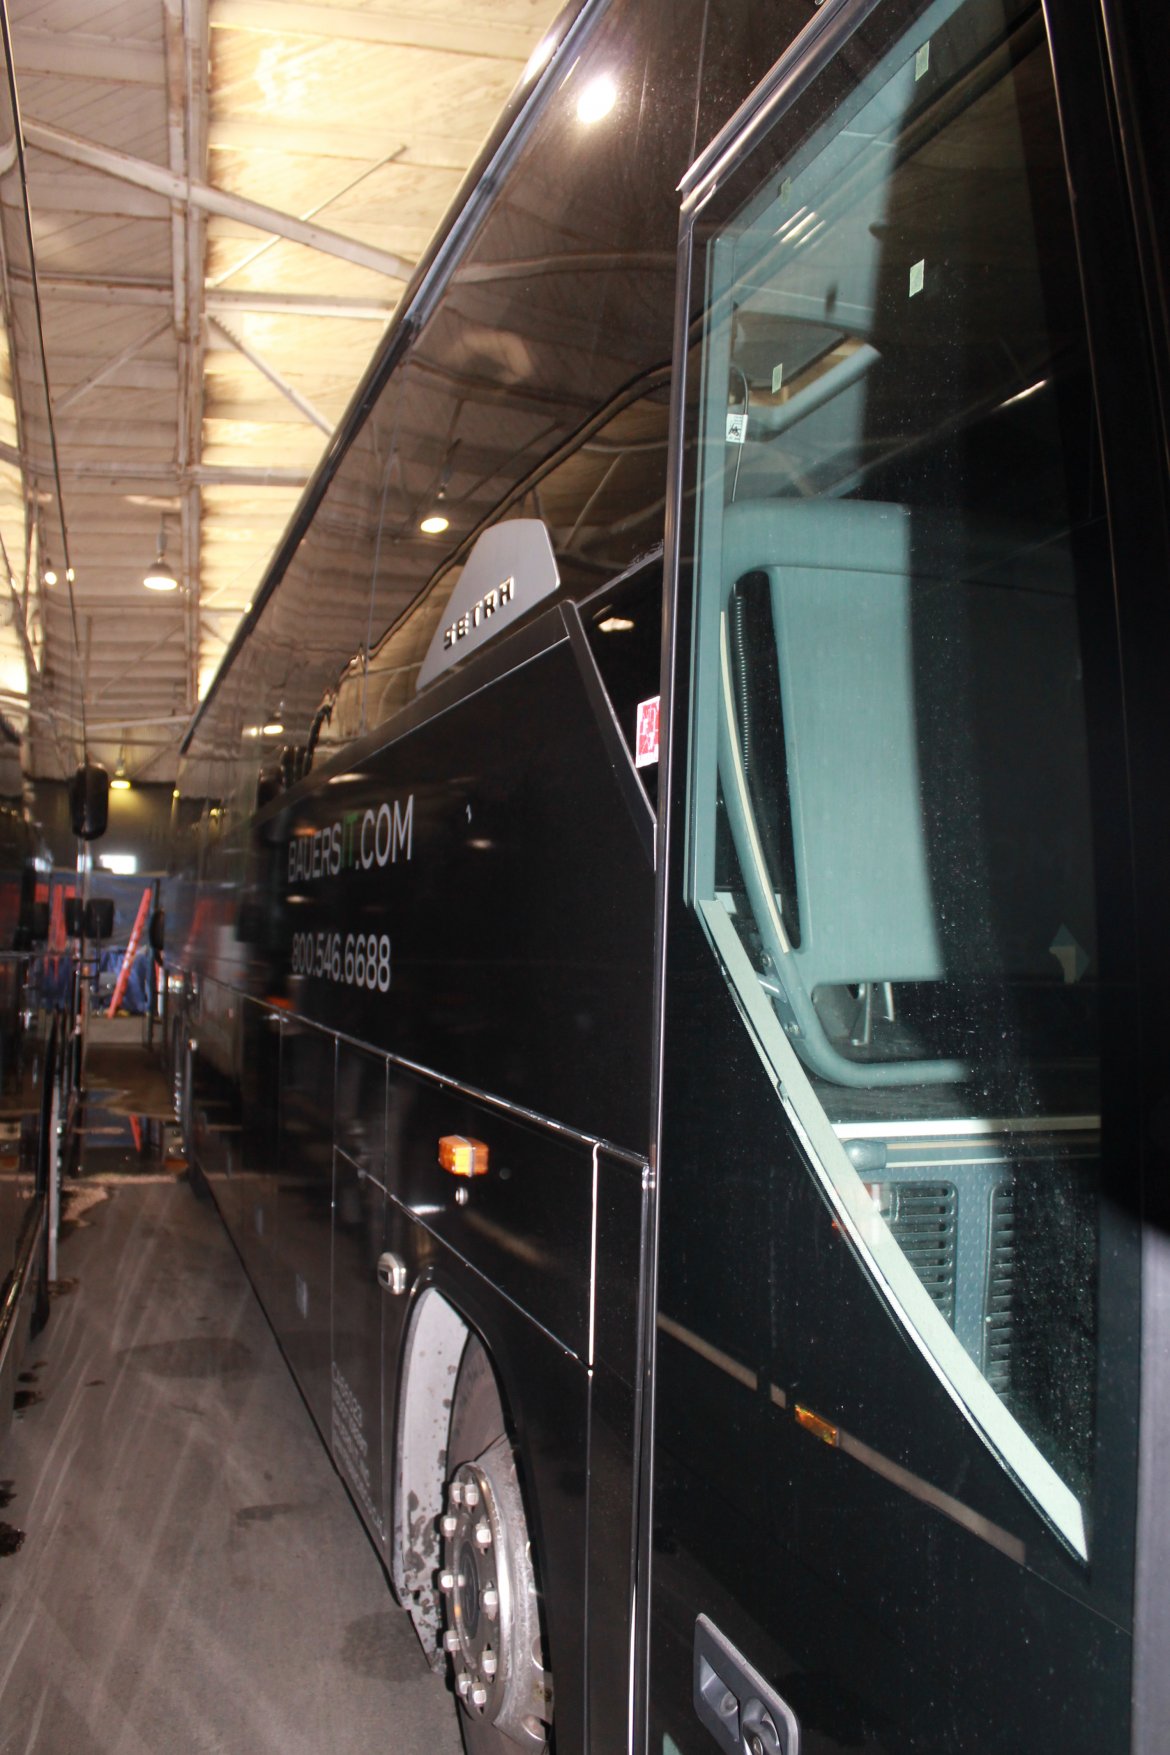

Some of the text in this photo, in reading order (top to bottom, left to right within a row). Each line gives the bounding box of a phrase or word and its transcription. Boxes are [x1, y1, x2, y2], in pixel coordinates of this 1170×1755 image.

[443, 575, 515, 650] SETRA
[288, 794, 414, 883] BAUERSIT.COM
[291, 932, 391, 993] 800.546.6688
